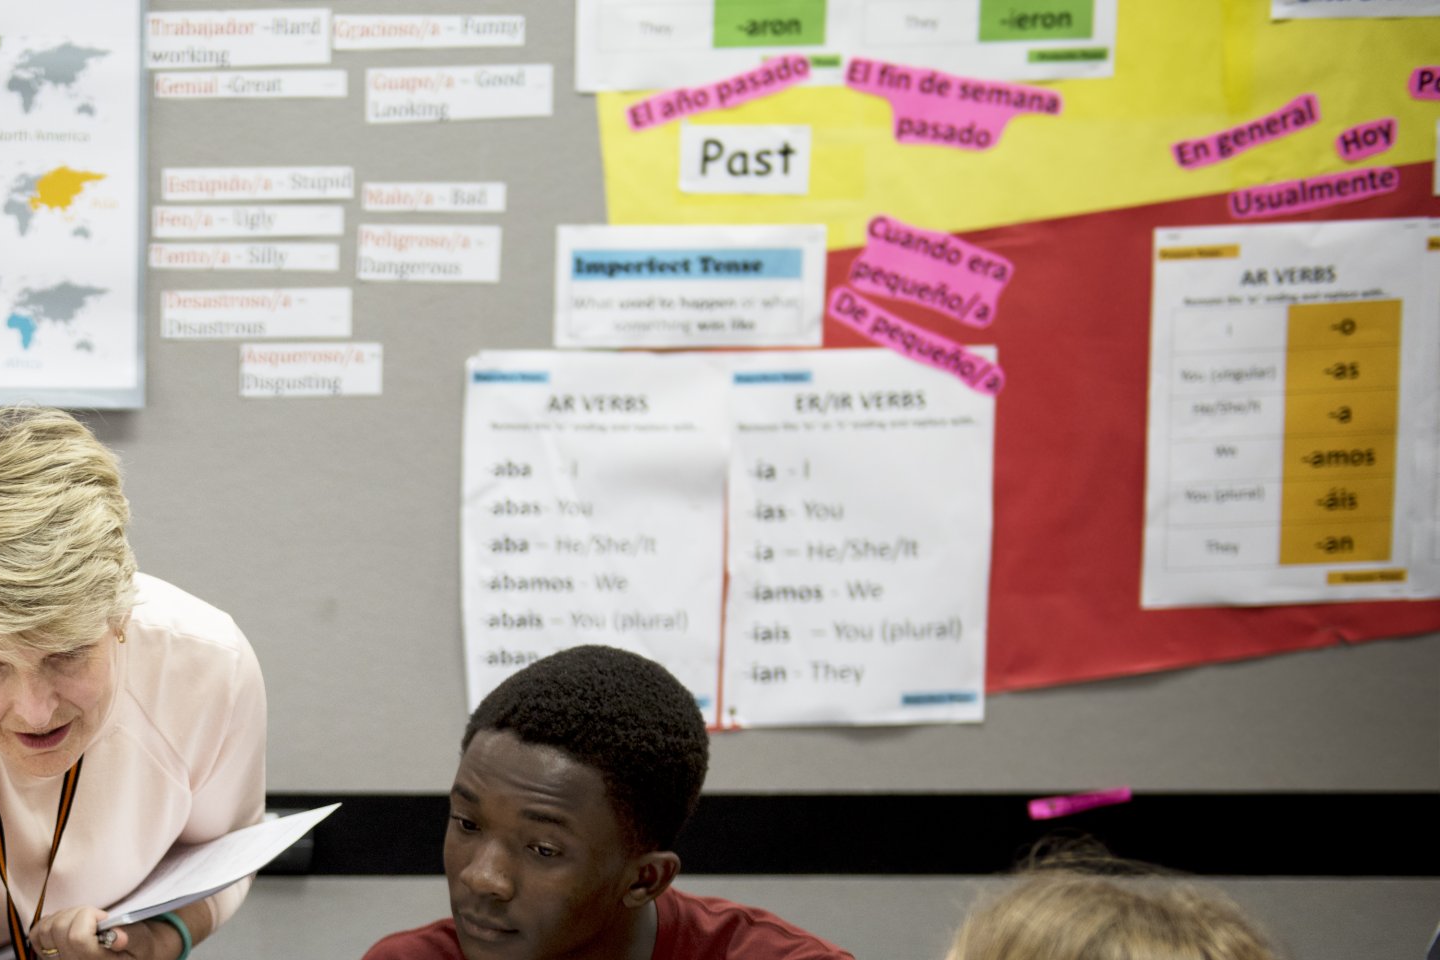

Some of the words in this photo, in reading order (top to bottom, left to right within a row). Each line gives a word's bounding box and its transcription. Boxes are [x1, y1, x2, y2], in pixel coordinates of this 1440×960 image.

[151, 48, 231, 67] working
[475, 69, 526, 88] Good
[847, 60, 871, 83] El
[877, 65, 912, 91] fin
[918, 71, 952, 97] de
[958, 83, 1061, 115] semana
[628, 102, 654, 128] El
[661, 88, 709, 119] año
[714, 56, 809, 106] pasado
[896, 117, 991, 149] pasado
[1175, 141, 1210, 167] En
[1215, 99, 1315, 158] general
[1340, 122, 1393, 155] Hoy
[700, 138, 796, 177] Past
[1232, 168, 1397, 216] Usualmente
[247, 247, 288, 266] Silly
[868, 216, 961, 265] Cuando
[967, 255, 1007, 281] era
[574, 256, 691, 278] Imperfect
[698, 255, 763, 274] Tense
[1240, 269, 1268, 286] AR
[1275, 266, 1336, 284] VERBS
[851, 262, 990, 321] pequeño/a
[834, 291, 868, 321] De
[870, 316, 1001, 390] pequeño/a
[548, 394, 574, 413] AR
[582, 394, 649, 413] VERBS
[794, 393, 854, 414] ER/IR
[859, 391, 927, 411] VERBS
[1301, 449, 1376, 468] -amos
[803, 501, 845, 521] You
[846, 581, 885, 599] We
[833, 621, 874, 642] You
[881, 615, 963, 644] (plural)
[810, 661, 865, 685] They
